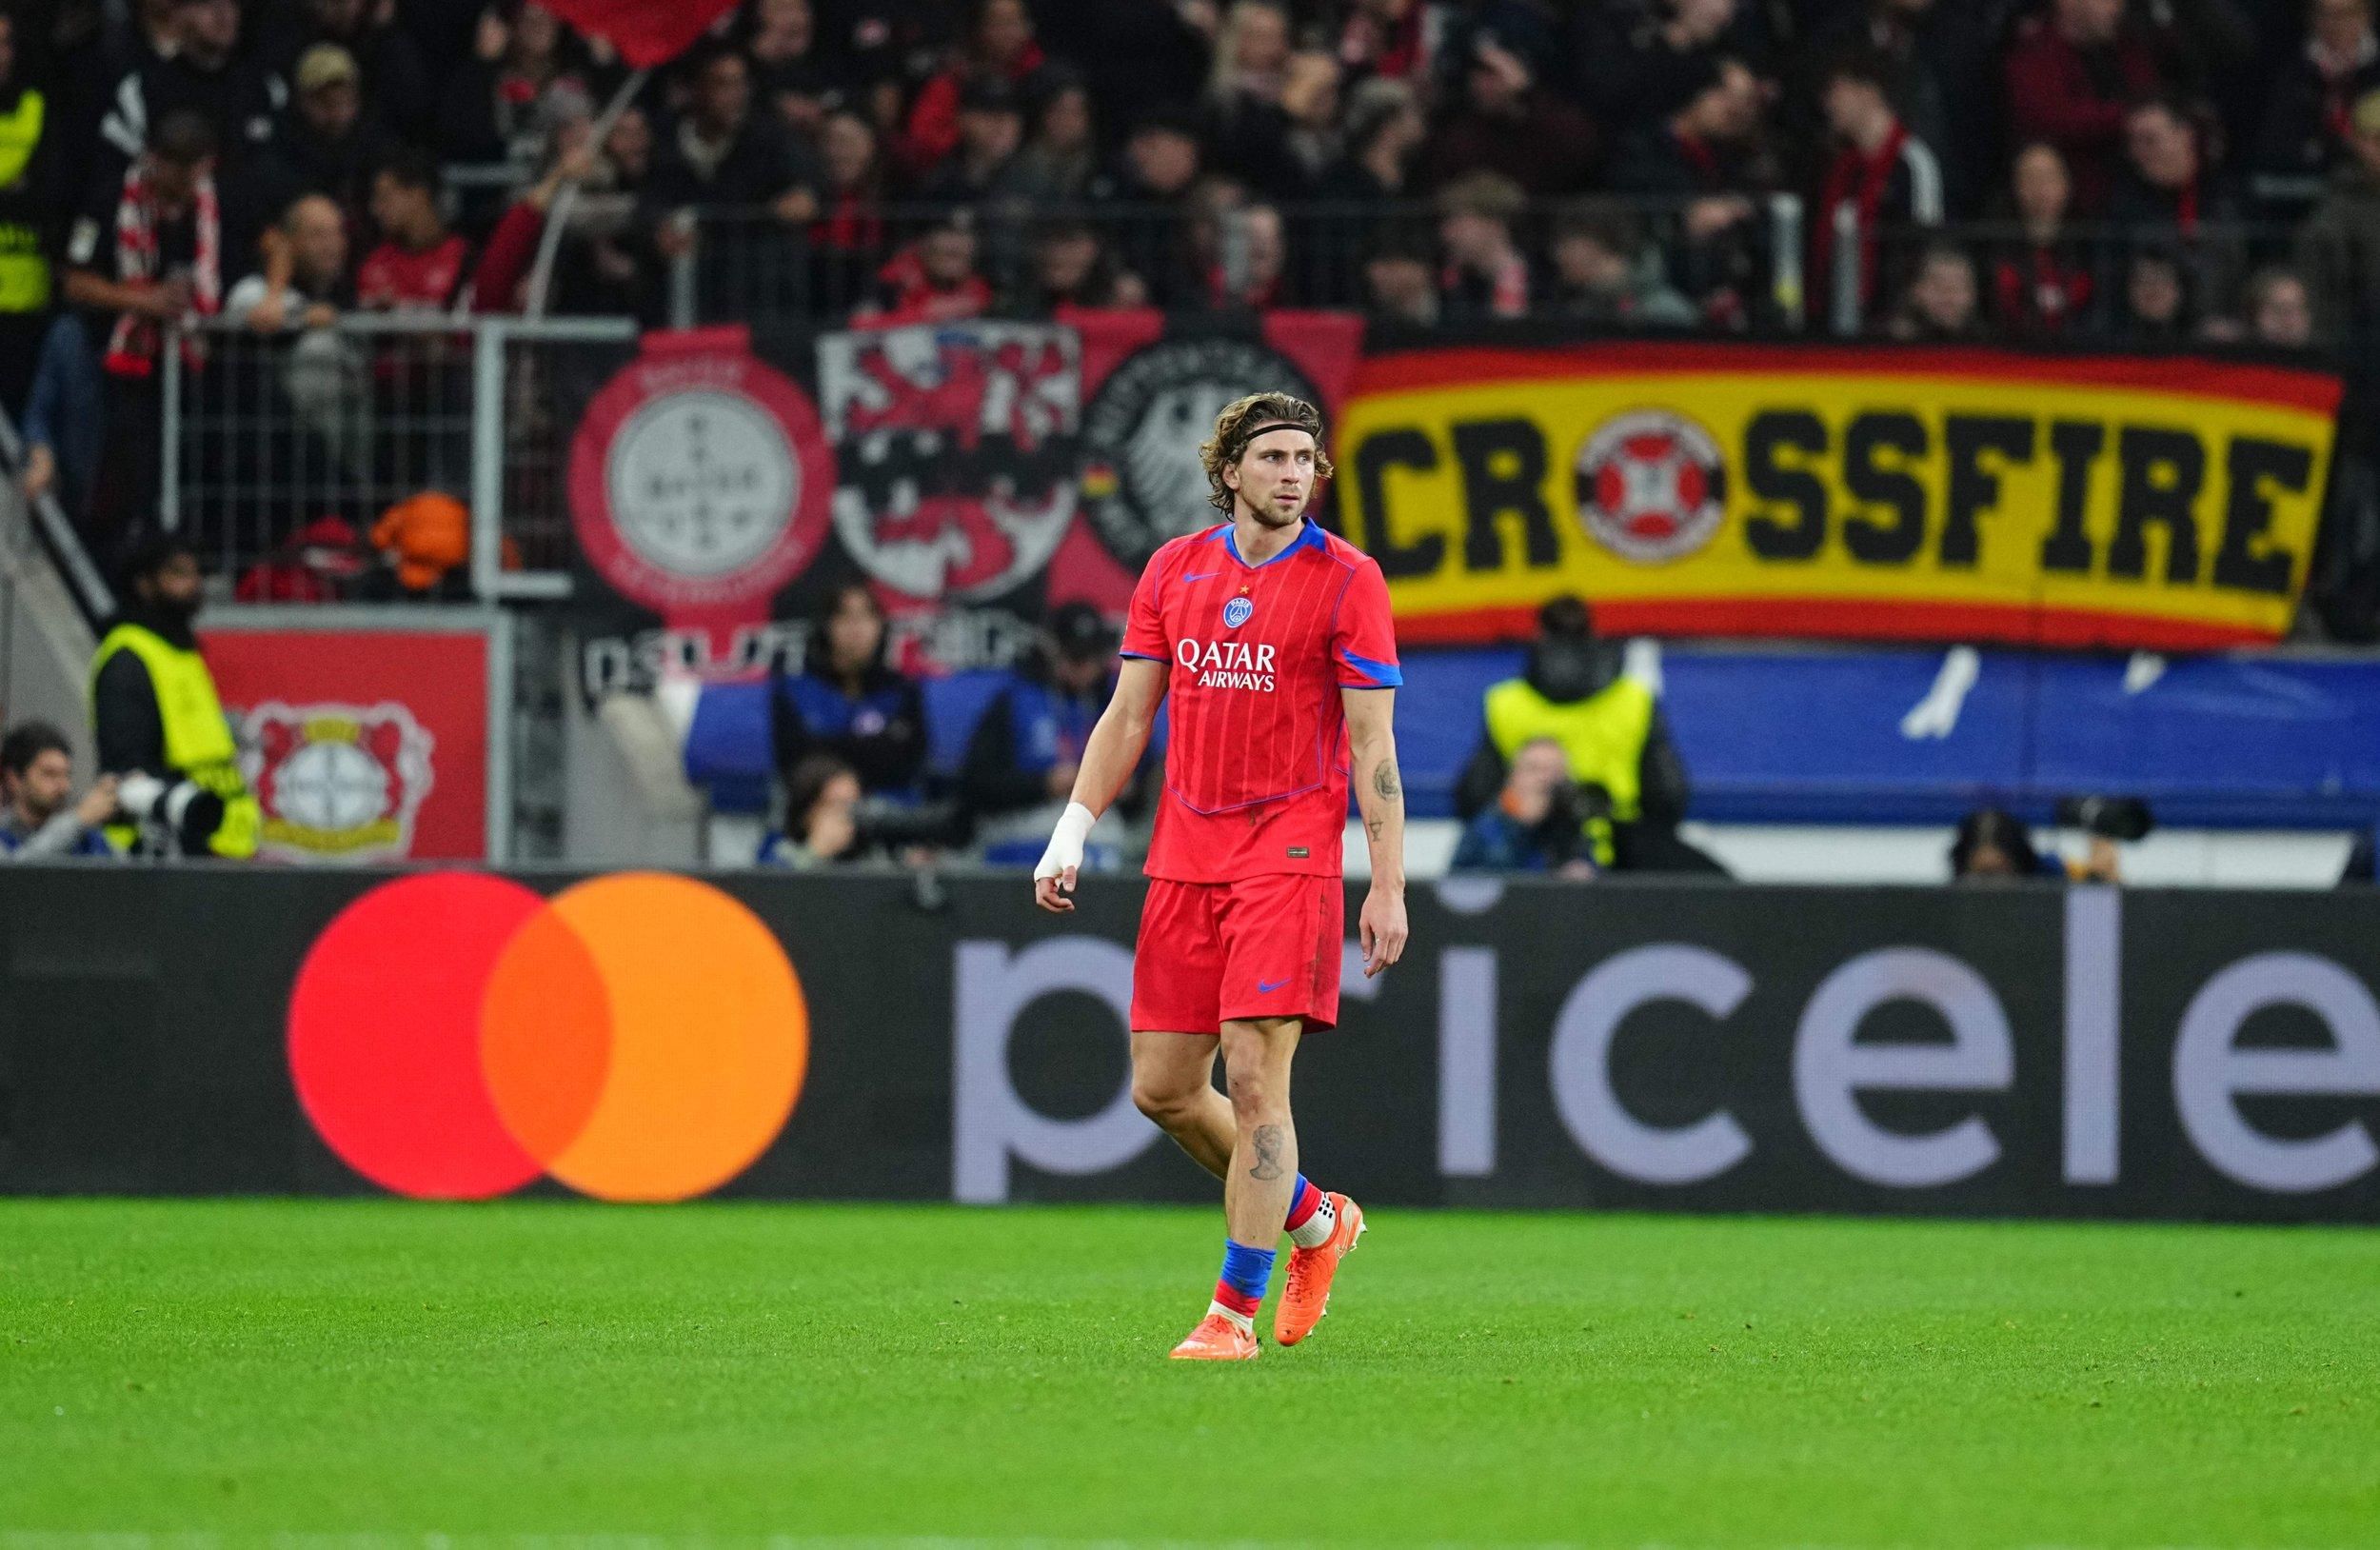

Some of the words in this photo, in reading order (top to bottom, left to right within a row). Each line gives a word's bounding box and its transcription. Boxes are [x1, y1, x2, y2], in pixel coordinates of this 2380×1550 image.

[1178, 638, 1276, 673] QATAR
[1198, 669, 1275, 692] AIRWAYS
[955, 878, 2380, 1203] picele
